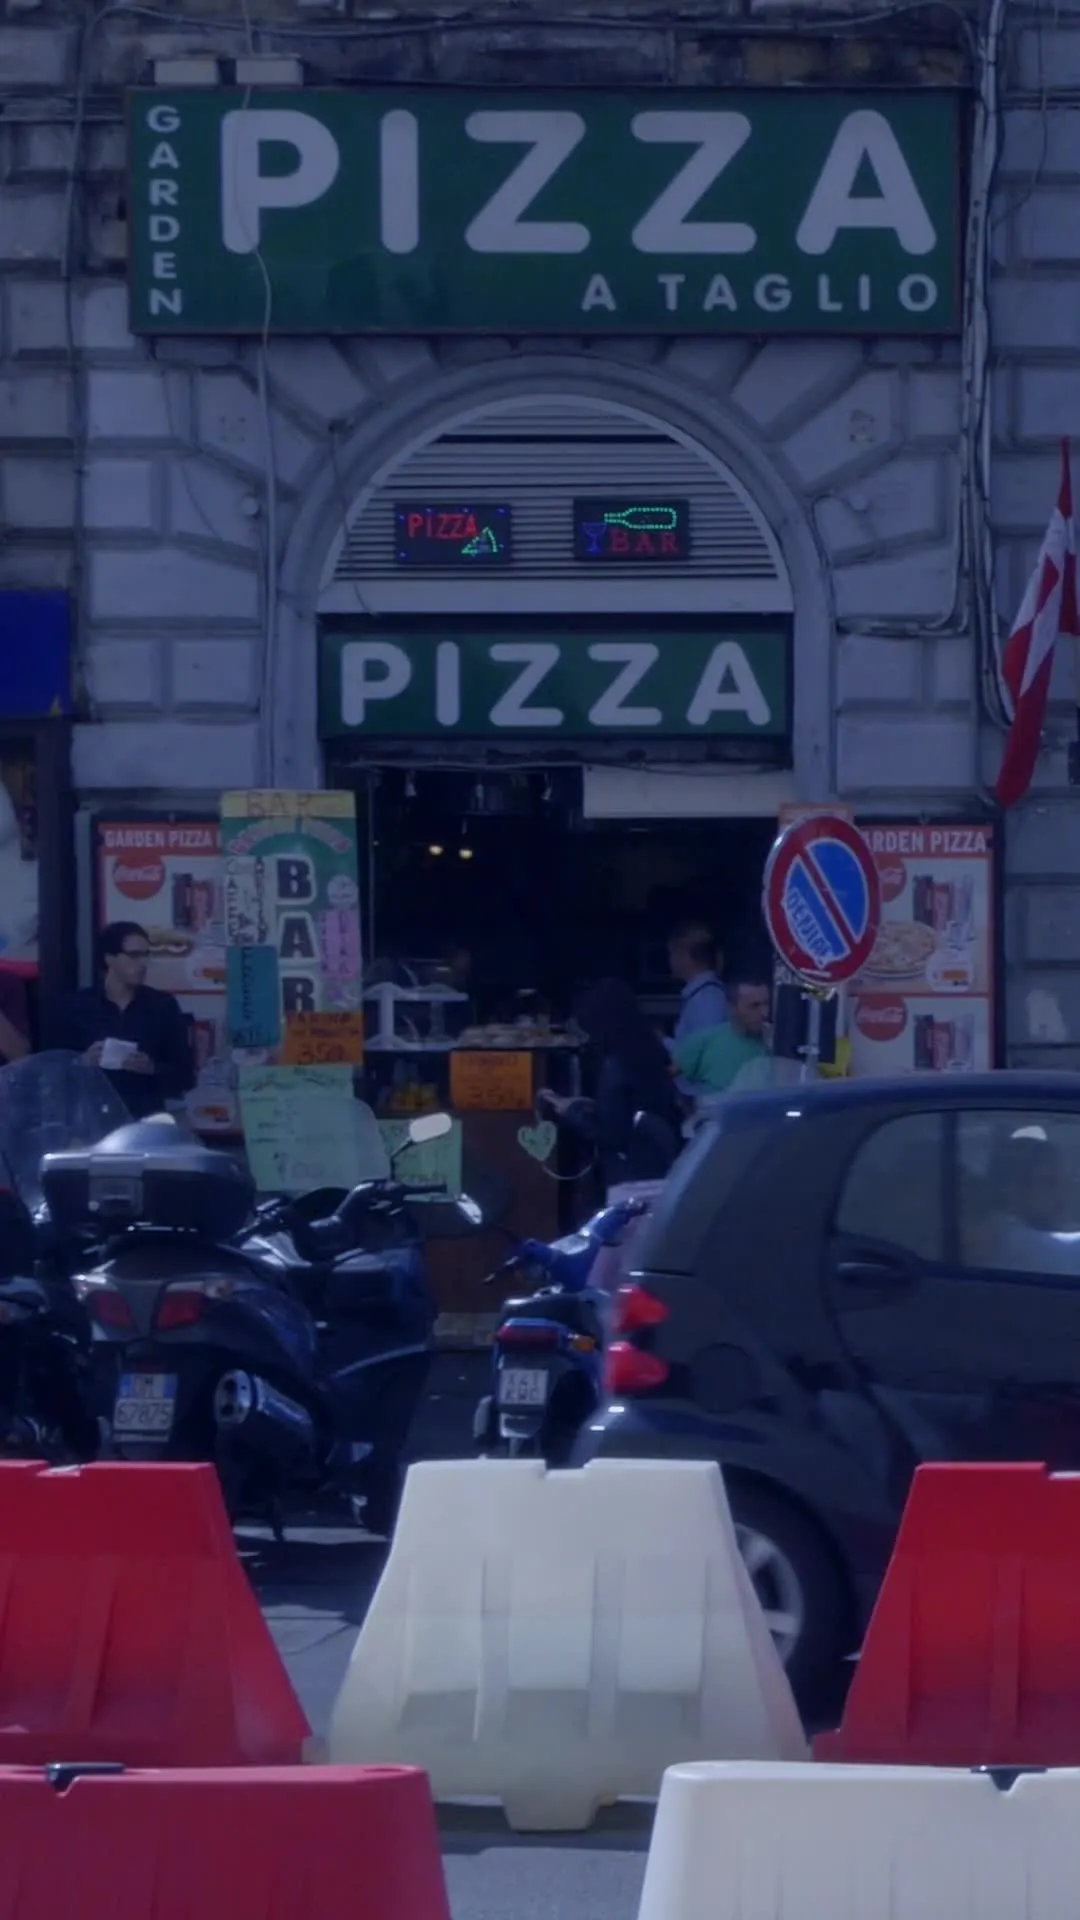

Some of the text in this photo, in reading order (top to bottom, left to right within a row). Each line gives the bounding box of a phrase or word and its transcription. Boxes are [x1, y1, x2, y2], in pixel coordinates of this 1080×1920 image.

[221, 108, 938, 256] PIZZA
[145, 104, 183, 317] GARDEN
[581, 273, 938, 313] A TAGLIO
[408, 513, 478, 538] PIZZA
[611, 529, 678, 551] BAR
[341, 641, 771, 727] PIZZA
[104, 830, 165, 849] GARDEN
[168, 830, 213, 849] PIZZA
[930, 831, 987, 853] PIZZA
[277, 859, 316, 1012] BAR
